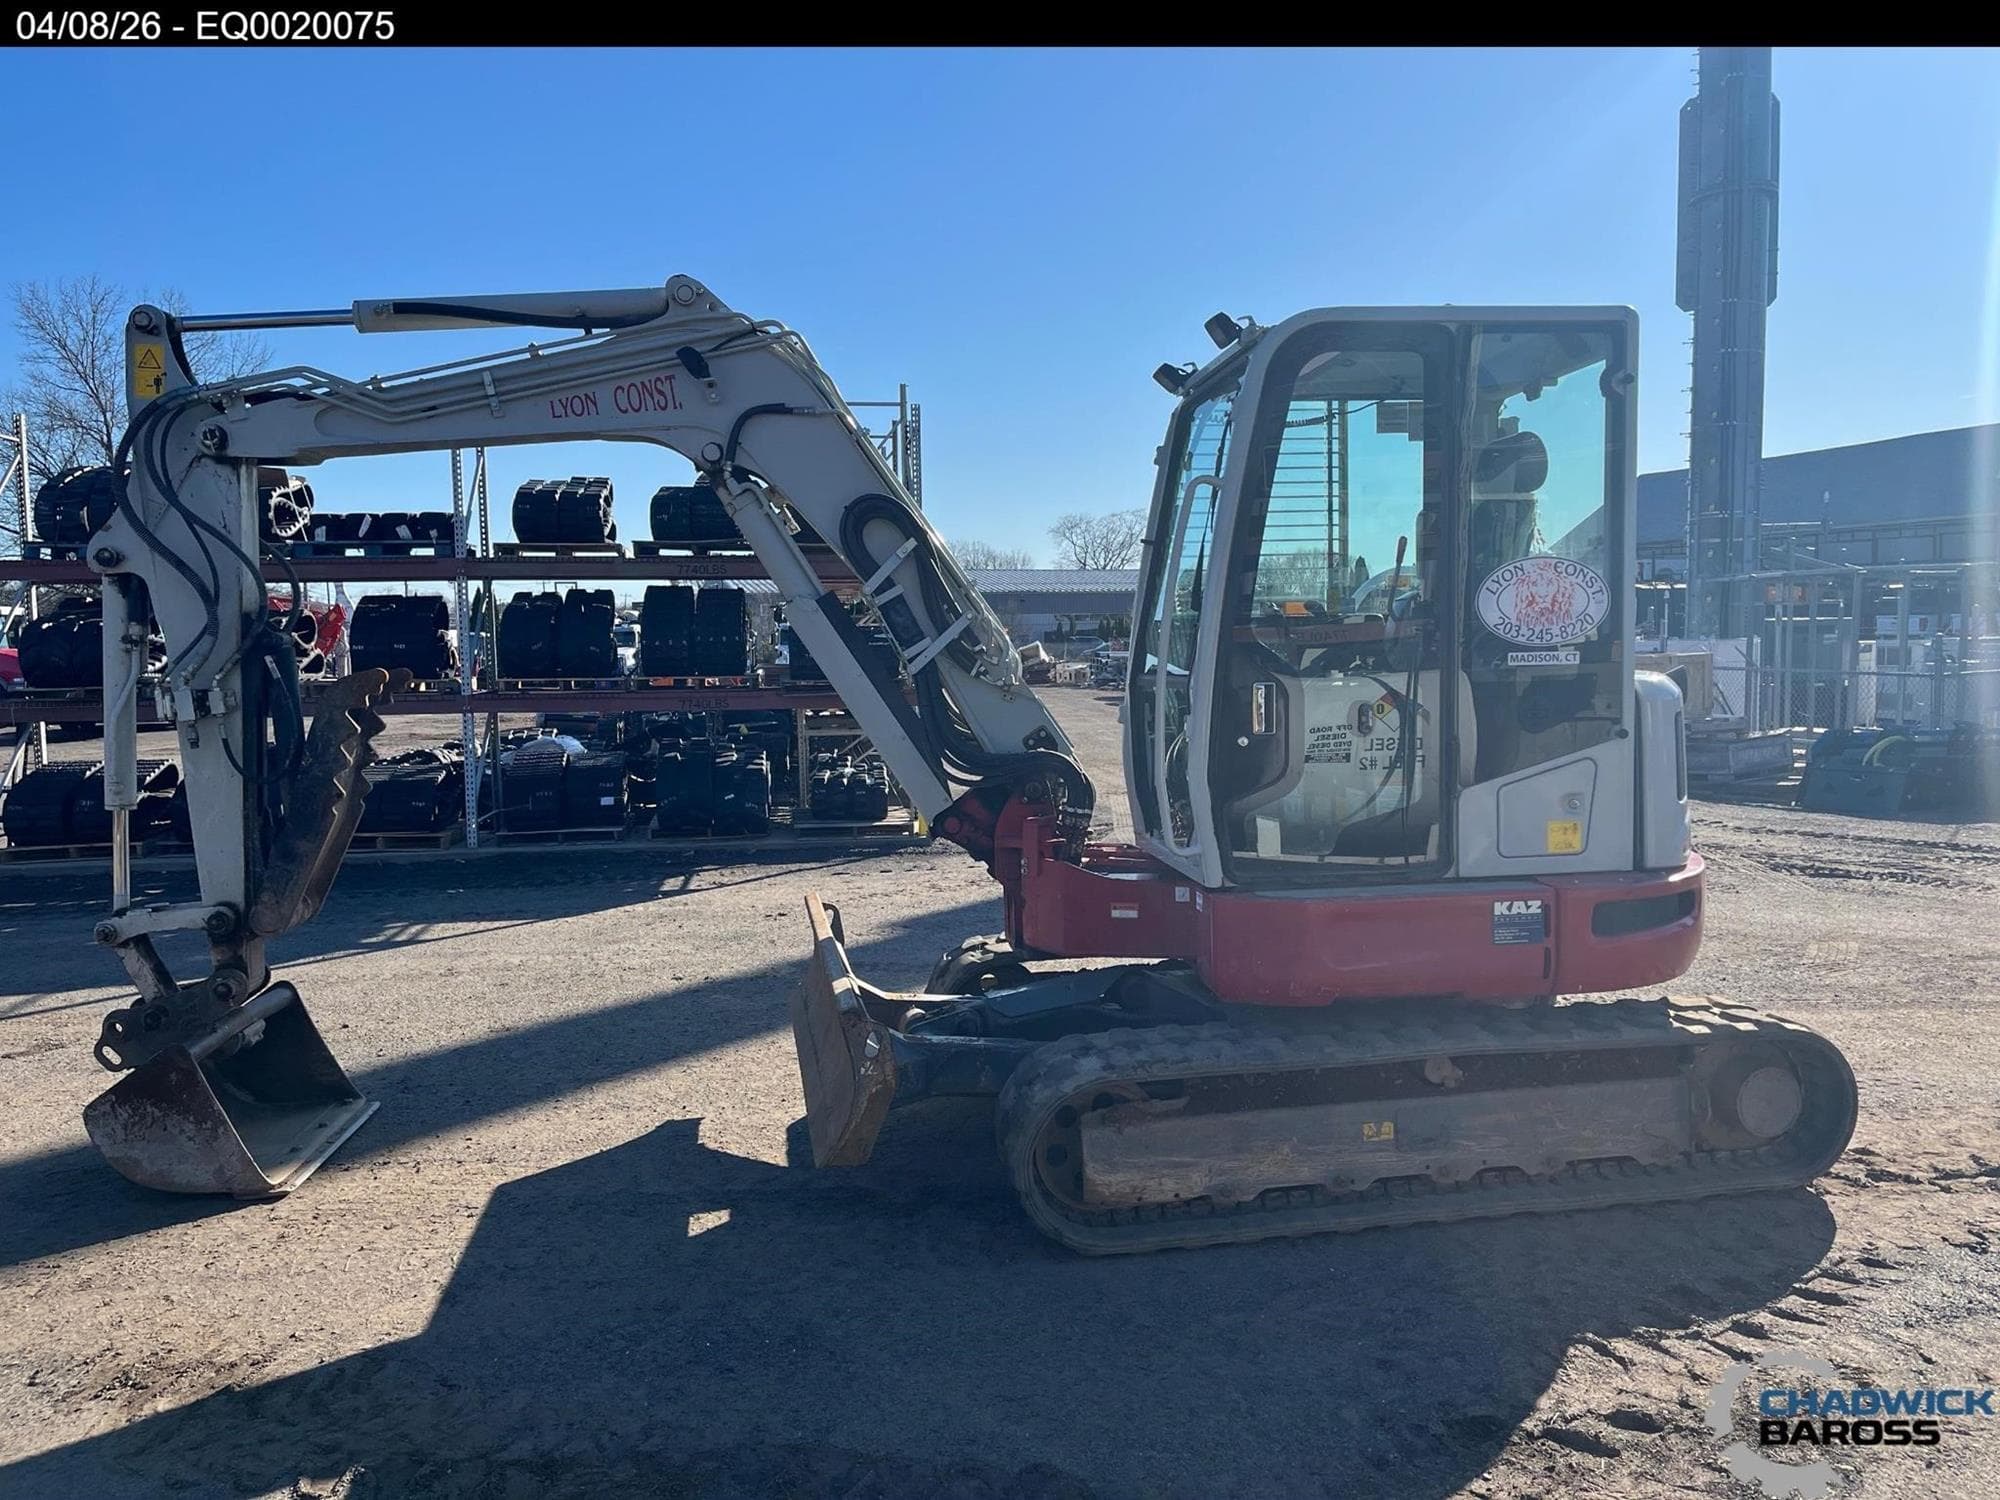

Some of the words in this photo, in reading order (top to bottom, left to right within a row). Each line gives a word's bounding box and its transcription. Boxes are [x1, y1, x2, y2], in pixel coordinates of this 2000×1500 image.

[549, 391, 599, 418] LYON
[613, 374, 683, 414] CONST.
[677, 564, 728, 575] 7740LBS
[1485, 563, 1526, 596] LYON
[1553, 561, 1605, 600] CONST.
[1493, 612, 1595, 643] 203-245-8220
[1509, 653, 1562, 663] MADISON,
[1565, 652, 1578, 661] CT
[1494, 900, 1542, 915] KAZ
